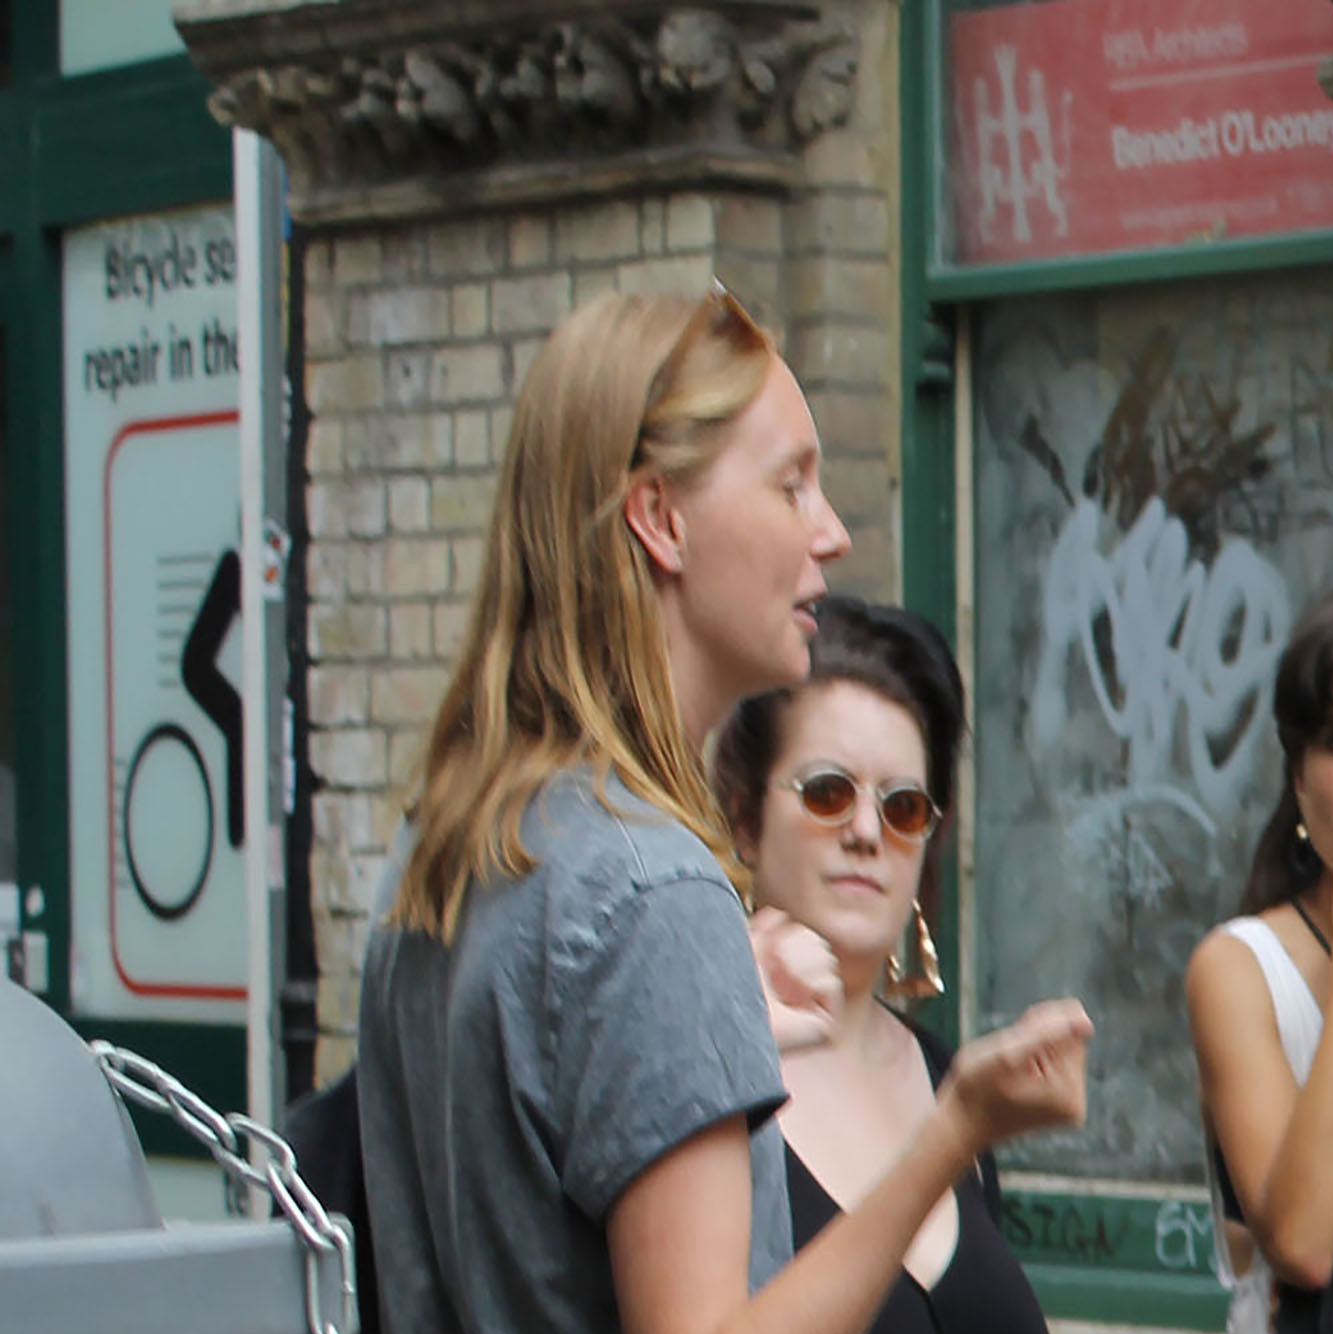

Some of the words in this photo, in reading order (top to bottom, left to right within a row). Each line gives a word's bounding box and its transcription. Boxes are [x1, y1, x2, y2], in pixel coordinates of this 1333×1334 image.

[1112, 116, 1219, 169] Benedict
[105, 231, 196, 309] Bicycle
[84, 324, 160, 404] repair
[168, 322, 194, 382] in
